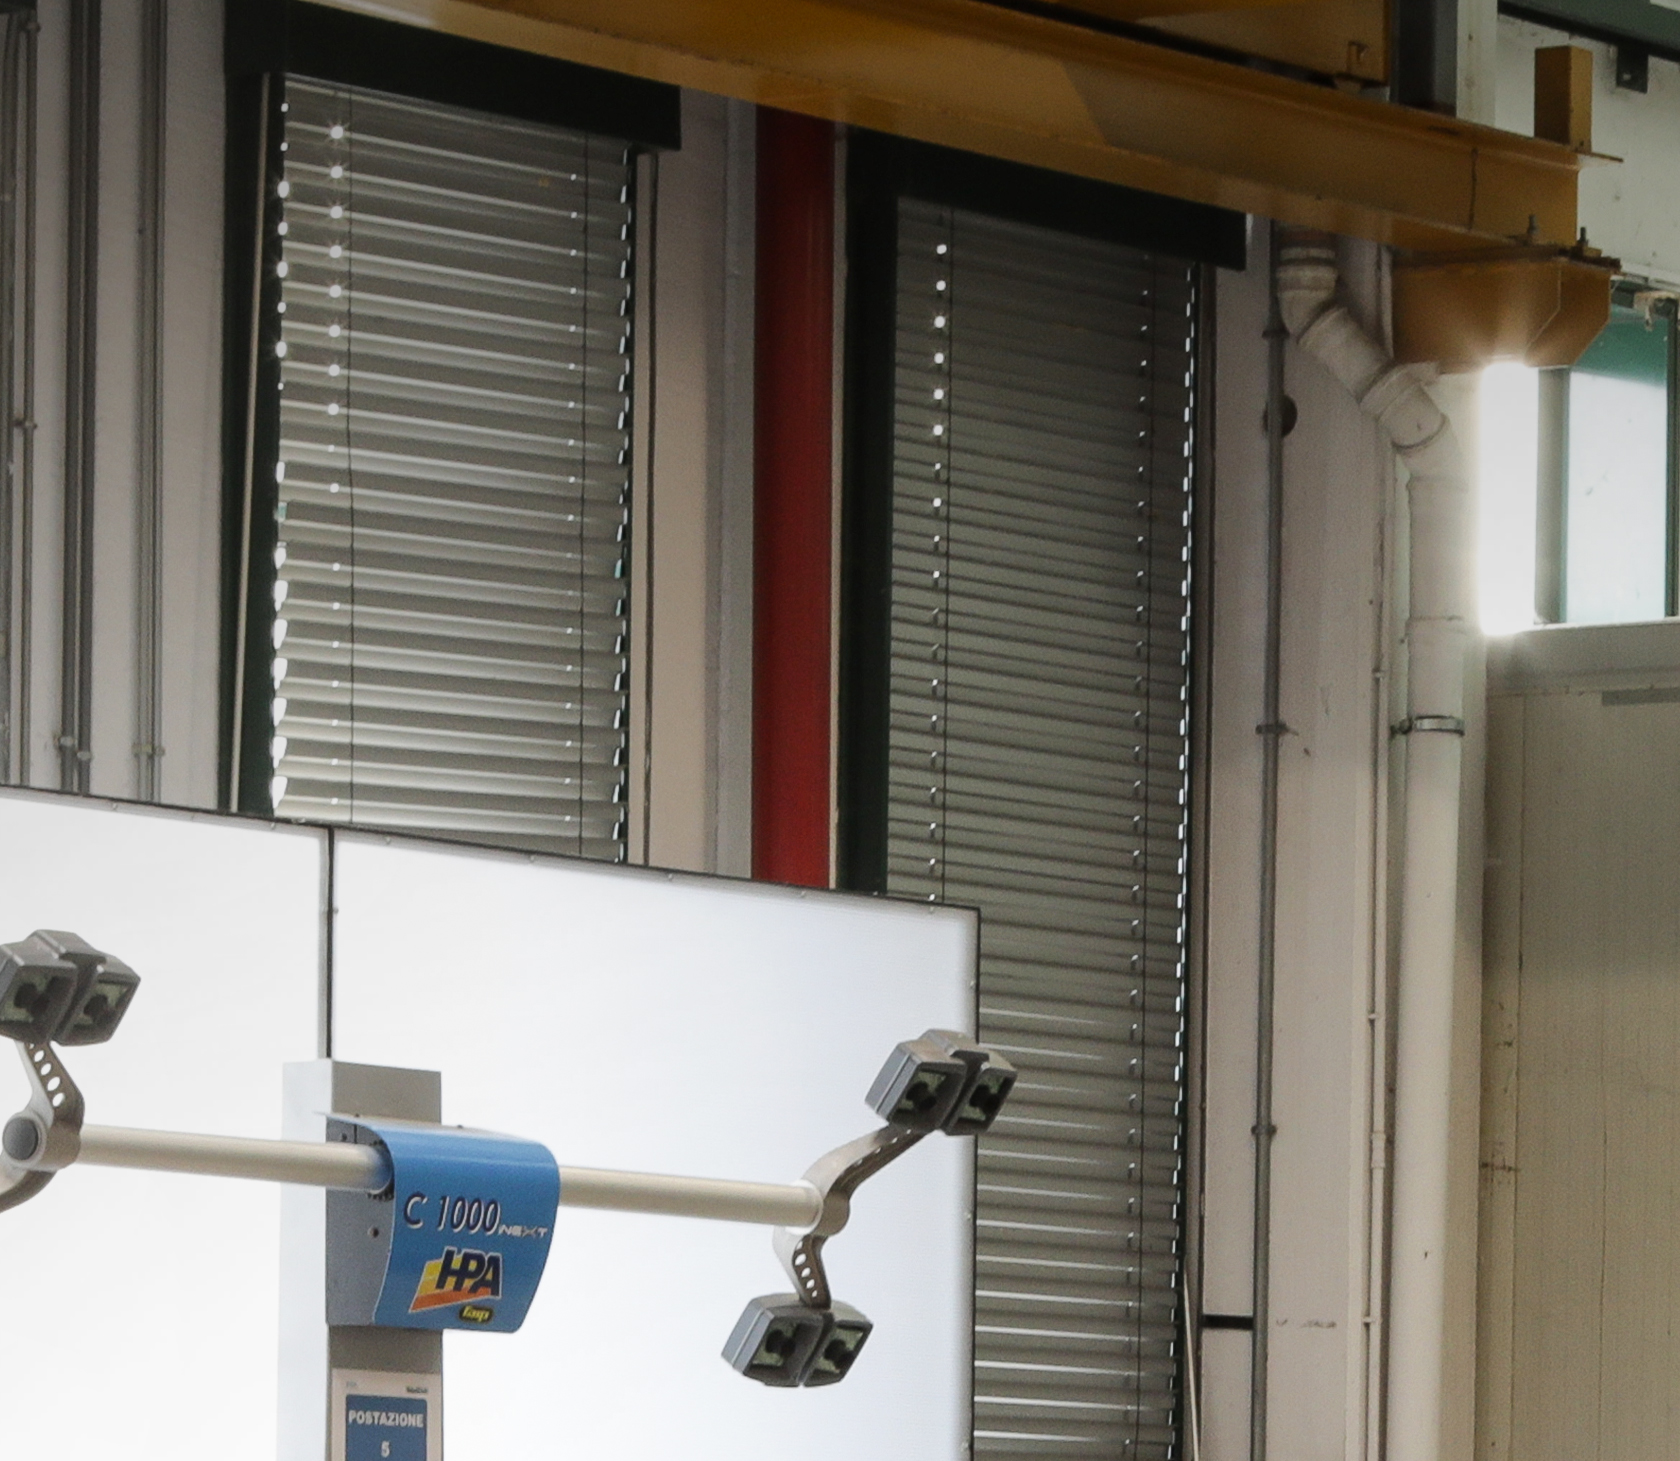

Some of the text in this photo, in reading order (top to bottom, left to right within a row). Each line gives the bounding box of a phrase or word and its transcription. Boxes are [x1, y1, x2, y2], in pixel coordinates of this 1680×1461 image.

[403, 1192, 428, 1229] C
[434, 1246, 502, 1299] HPA
[348, 1409, 425, 1428] POSTAZIONE
[380, 1441, 390, 1458] 5
